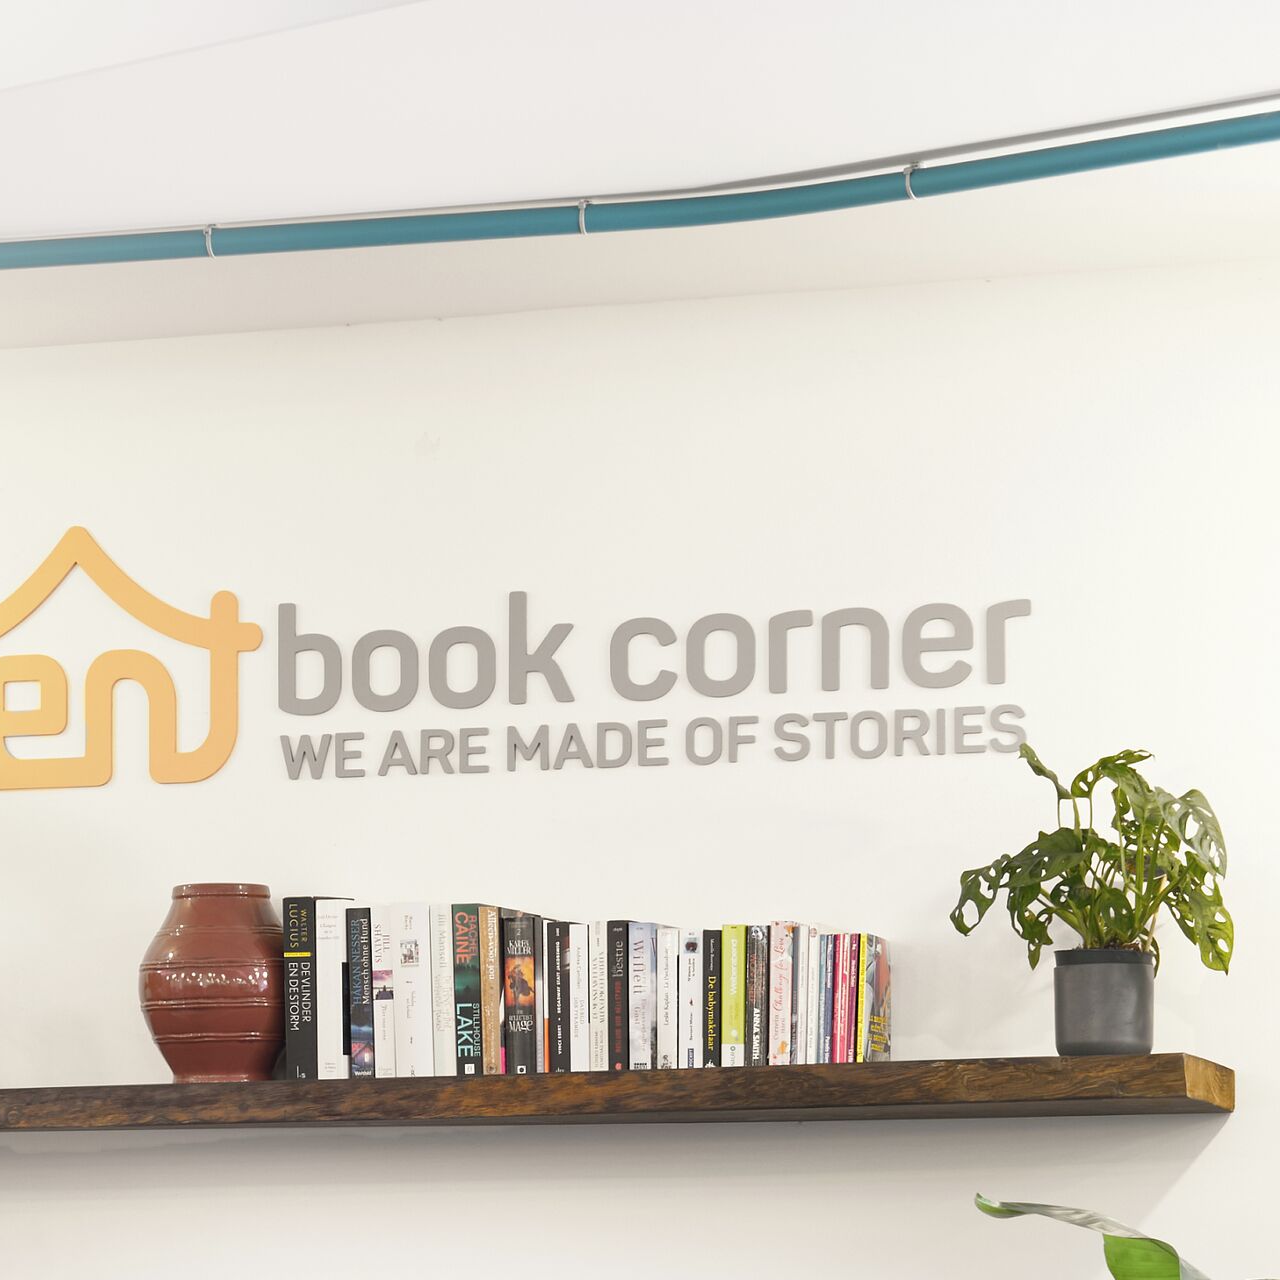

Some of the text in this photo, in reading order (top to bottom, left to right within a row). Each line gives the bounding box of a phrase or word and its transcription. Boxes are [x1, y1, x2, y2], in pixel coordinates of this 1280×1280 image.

[278, 591, 1030, 716] book corner
[280, 703, 1027, 780] WE ARE MADE OF STORIES
[289, 903, 299, 949] LUCIUS
[300, 909, 308, 944] WALTER
[351, 919, 361, 963] NESSER
[374, 923, 383, 963] SHALVIS
[455, 912, 470, 965] CAINE
[469, 914, 478, 956] RACHEL
[288, 962, 299, 977] EN
[360, 918, 370, 1005] Mensch ohne Hund
[289, 994, 300, 1032] STORM
[301, 977, 312, 1022] VLINDER
[705, 976, 717, 1051] De babymakelaar
[456, 1003, 473, 1058] LAKE
[472, 1002, 481, 1057] STILLHOUSE
[752, 1007, 761, 1060] ANNA SMITH
